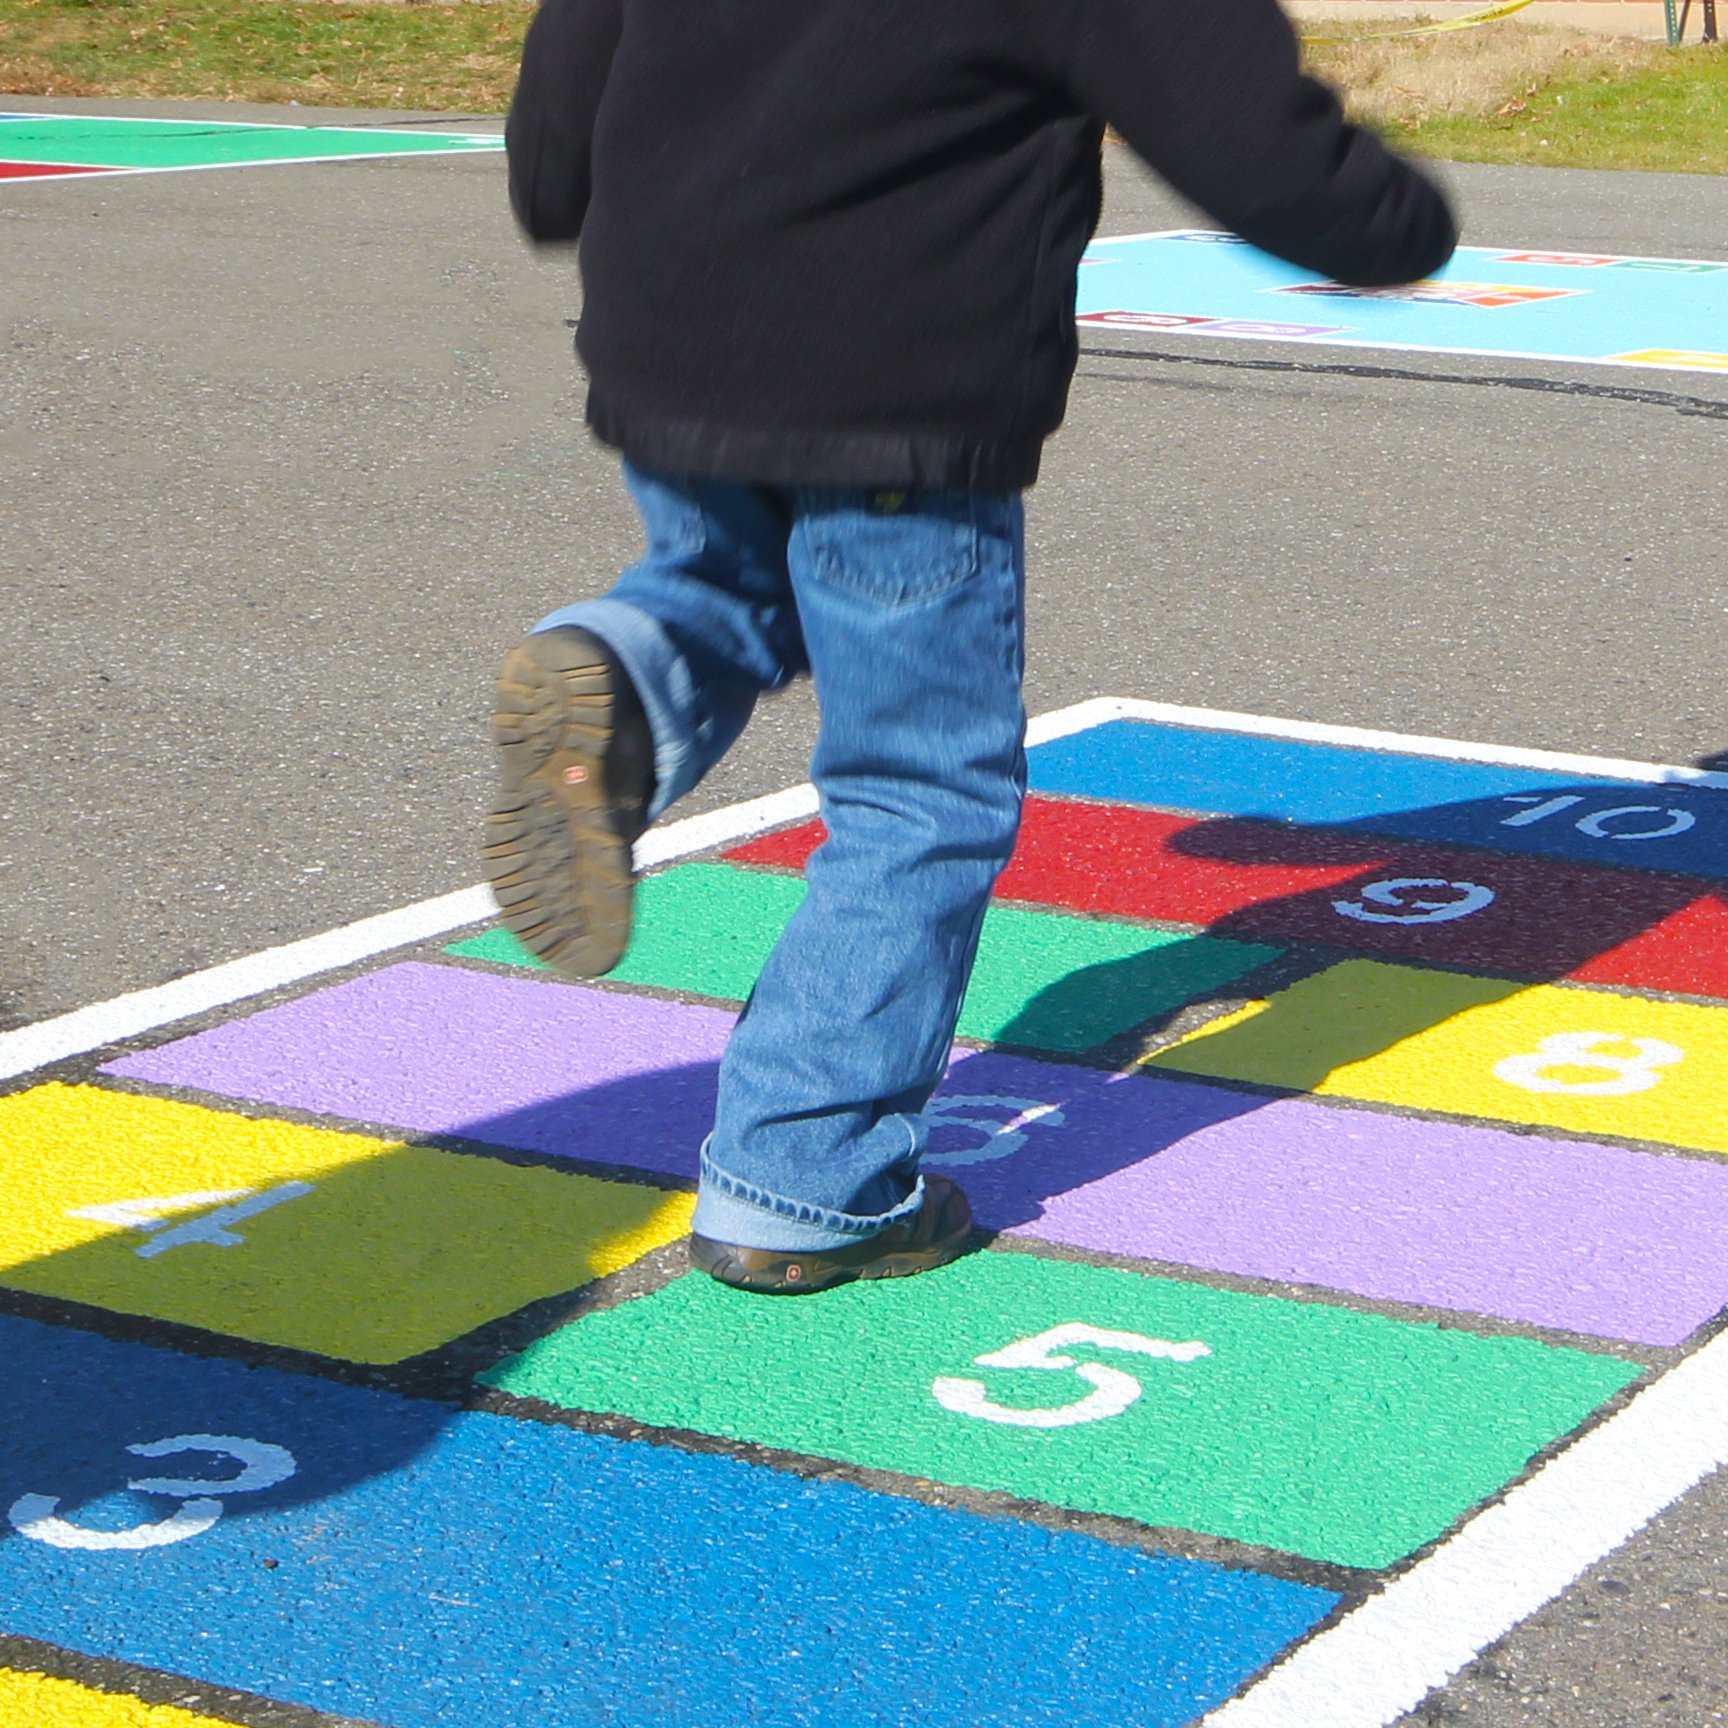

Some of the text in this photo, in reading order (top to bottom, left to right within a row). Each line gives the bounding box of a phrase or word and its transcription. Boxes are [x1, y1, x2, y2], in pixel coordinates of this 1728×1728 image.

[1501, 787, 1696, 841] 10
[1331, 877, 1496, 925] 9
[1493, 1029, 1686, 1097] 8
[63, 1179, 314, 1260] 4
[931, 1322, 1213, 1429] 5
[5, 1433, 297, 1552] 3
